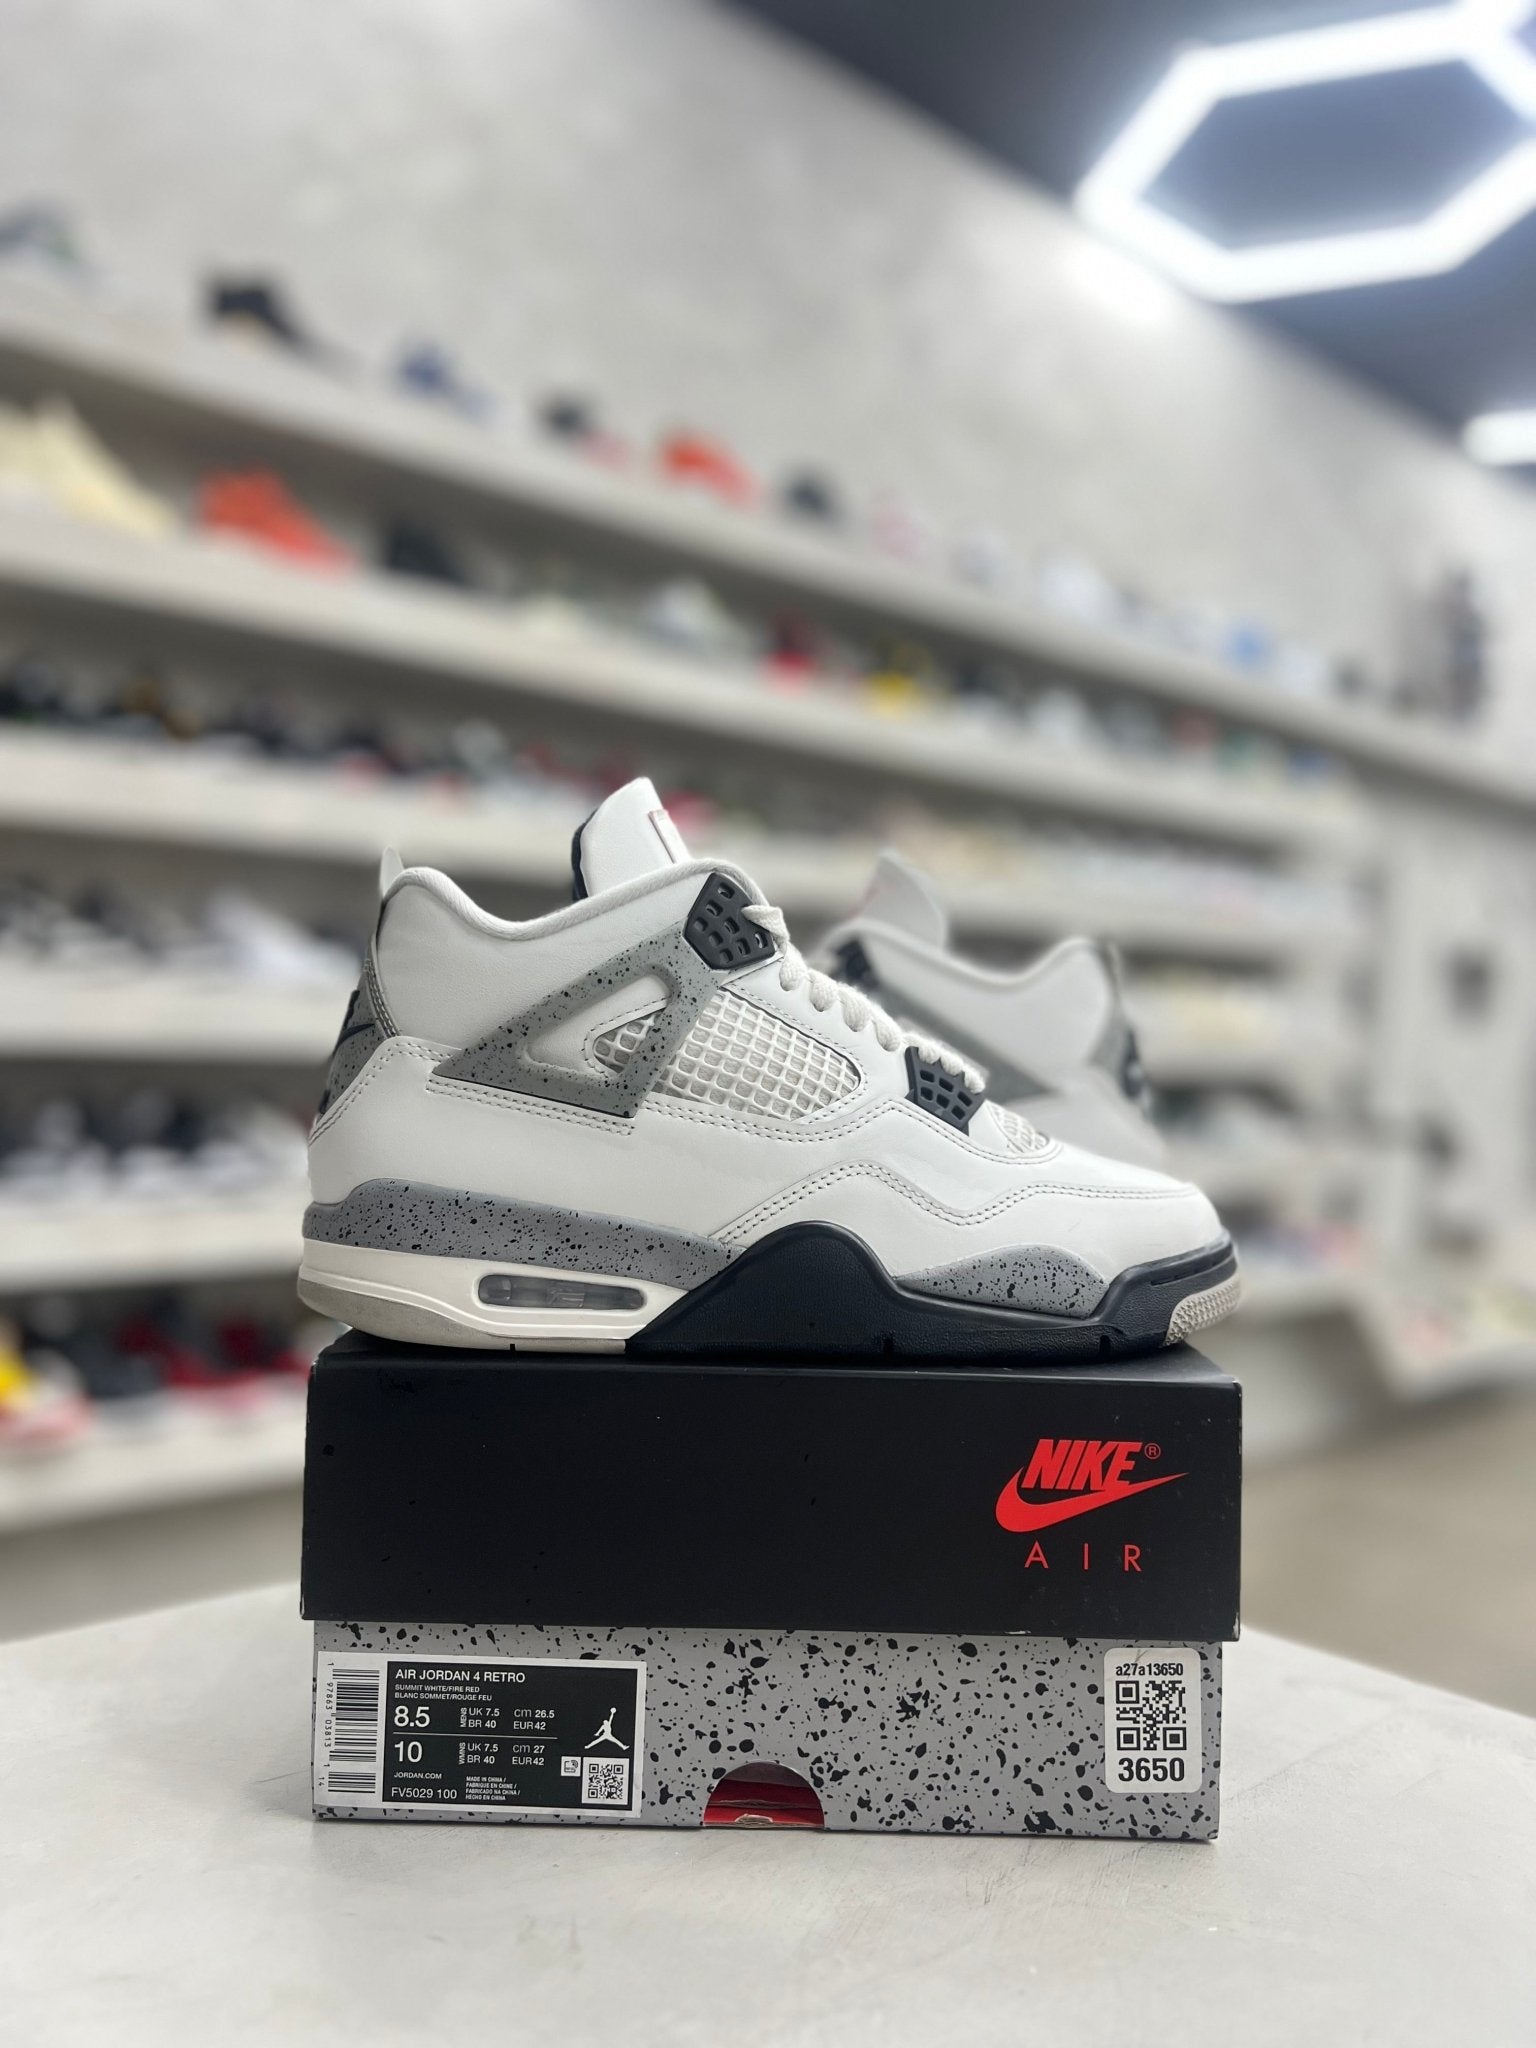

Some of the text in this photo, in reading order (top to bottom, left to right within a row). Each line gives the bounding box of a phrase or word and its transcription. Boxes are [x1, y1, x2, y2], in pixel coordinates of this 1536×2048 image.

[1021, 1438, 1142, 1491] NIKE
[395, 1669, 526, 1683] AIR JORDAN 4 RETRO
[1115, 1663, 1184, 1676] a27a13650
[393, 1705, 430, 1728] 8.5
[468, 1707, 500, 1717] UK 7.5
[514, 1709, 555, 1719] cm 26.5
[468, 1720, 497, 1729] BR 40
[394, 1740, 423, 1763] 10
[458, 1742, 466, 1765] WMNS
[467, 1743, 499, 1752] UK 7.5
[512, 1744, 545, 1754] cm 27
[467, 1754, 496, 1764] BR 40
[394, 1772, 442, 1780] JORDAN.COM
[1118, 1757, 1185, 1782] 3650
[391, 1787, 458, 1800] FV5029 100
